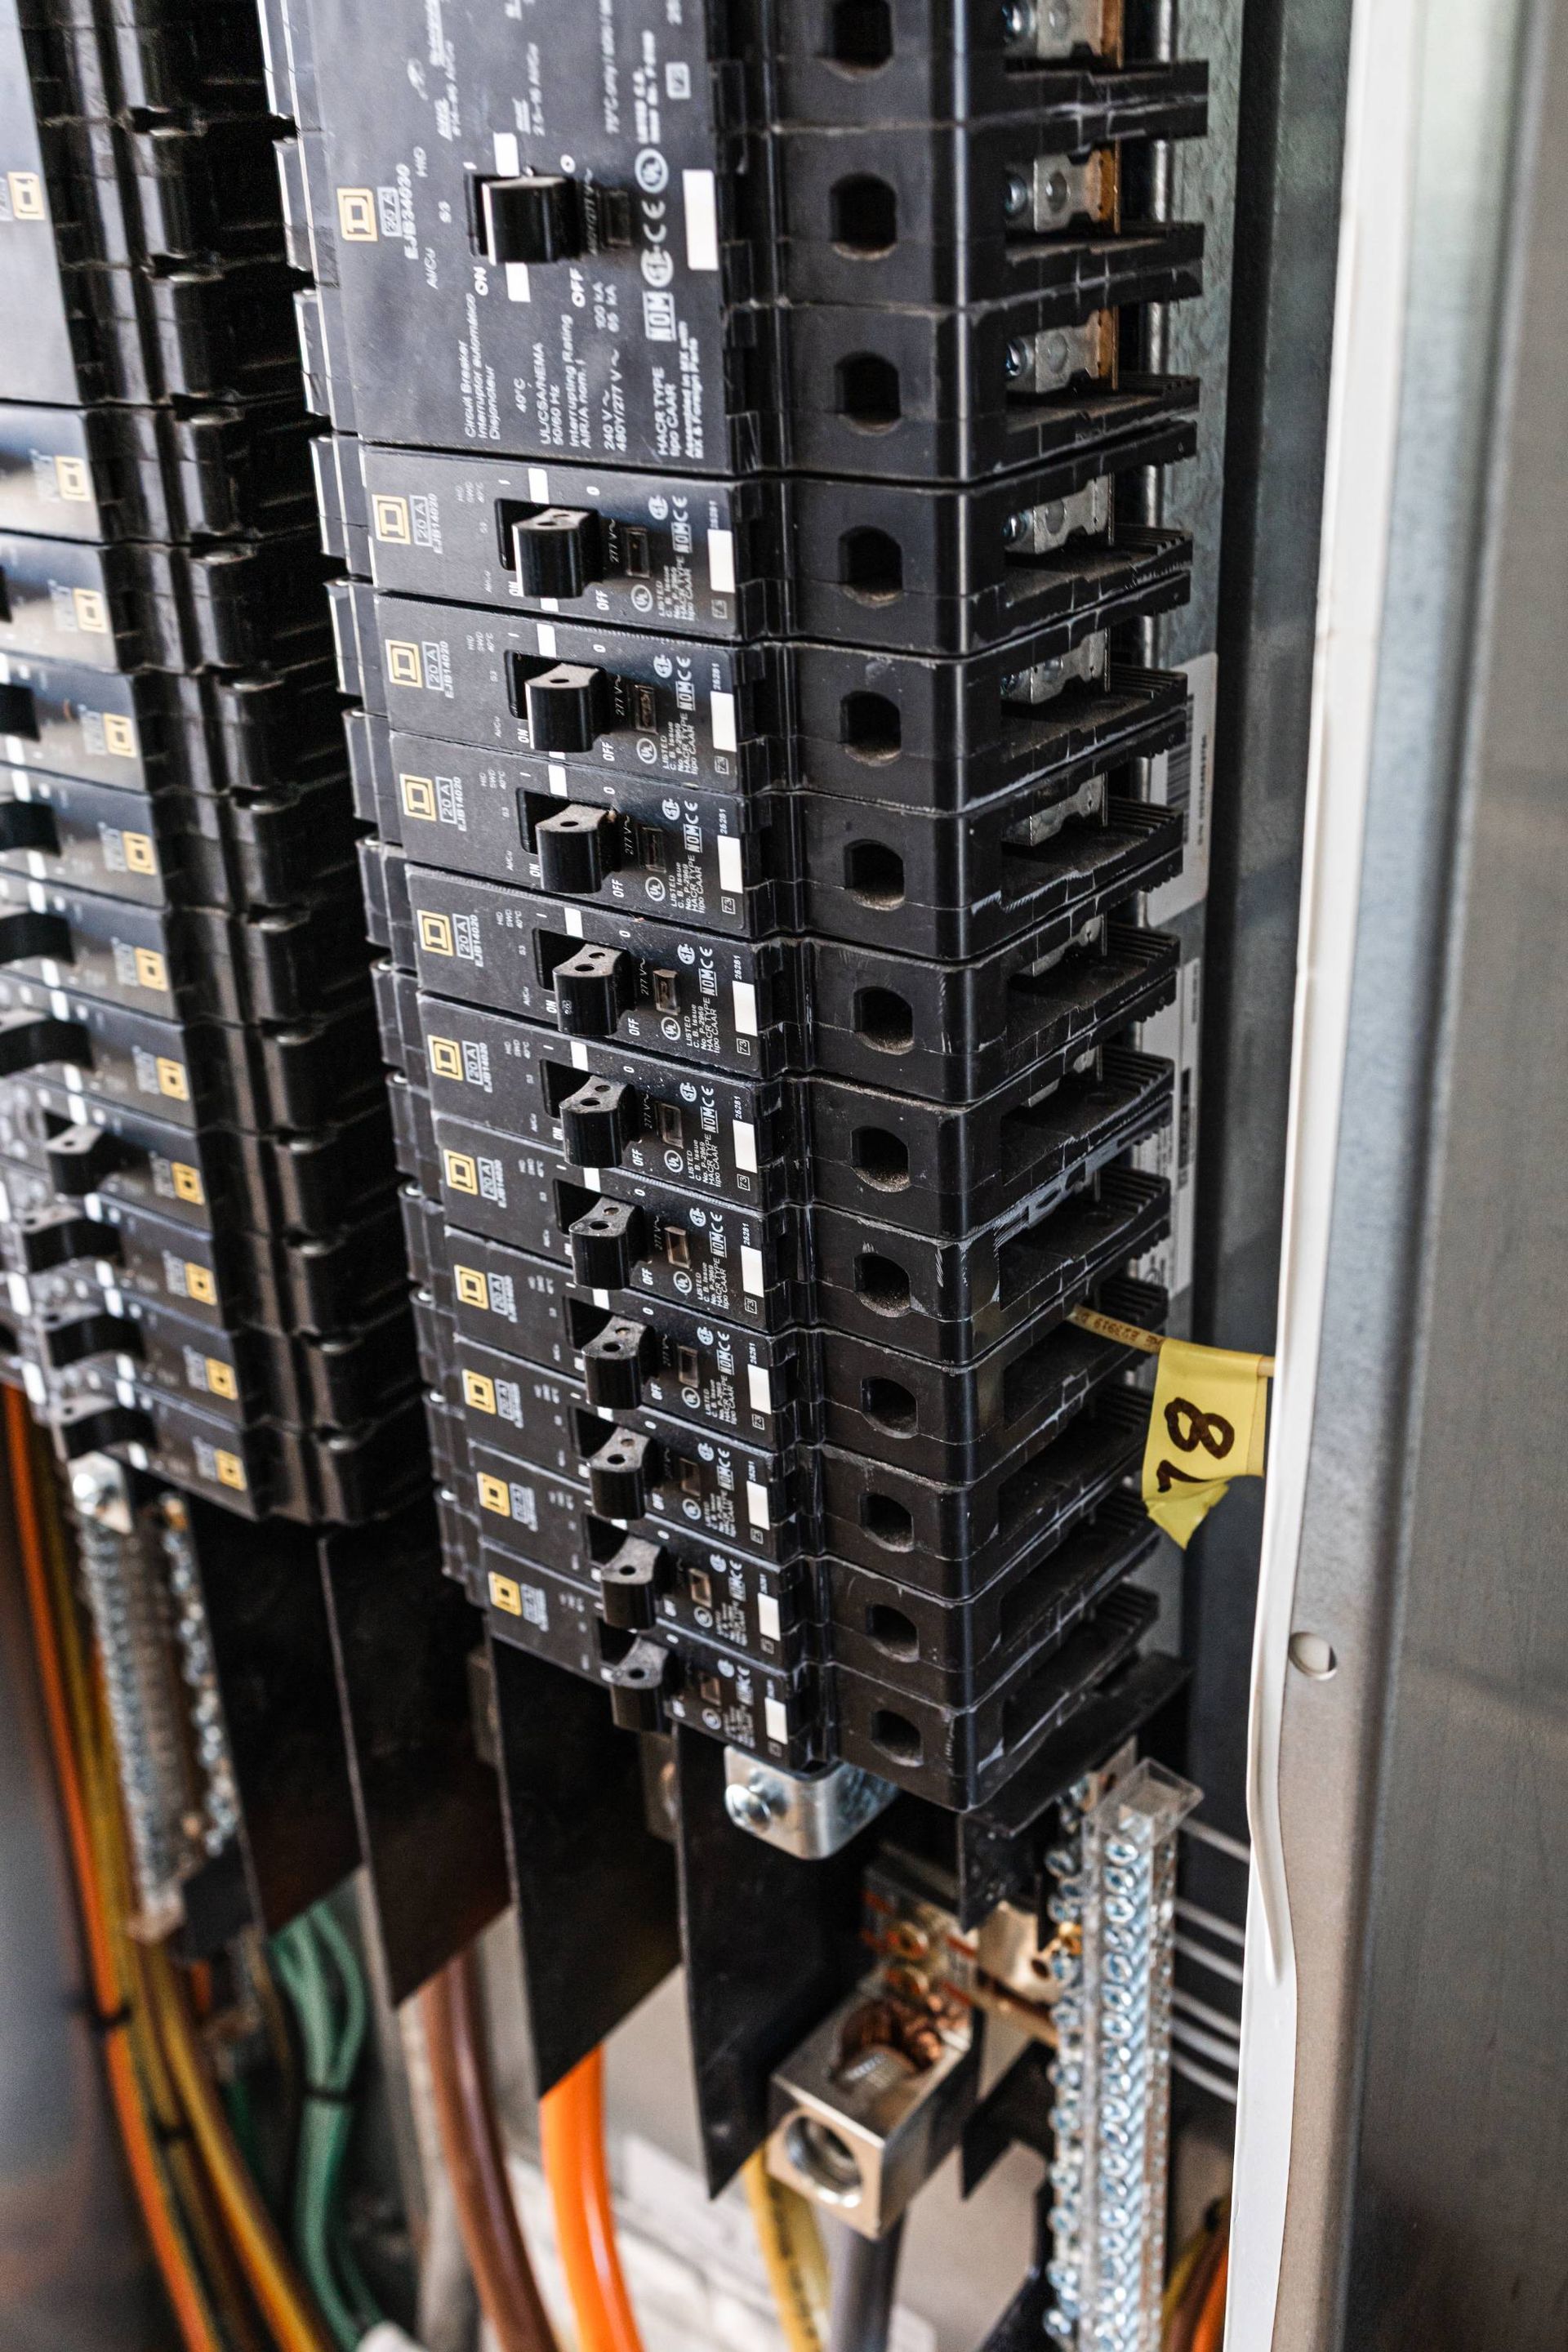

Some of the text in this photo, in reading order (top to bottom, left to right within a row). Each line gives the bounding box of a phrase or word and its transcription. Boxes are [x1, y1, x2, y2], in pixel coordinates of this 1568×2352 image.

[642, 200, 666, 243] CE
[474, 267, 488, 296] ON
[570, 268, 586, 307] OFF
[604, 284, 617, 305] kA
[592, 282, 606, 329] 100 kA
[646, 292, 673, 340] NOM
[458, 340, 472, 394] Breaker
[561, 314, 580, 447] Interrupting Rating
[610, 369, 622, 381] V
[473, 369, 488, 438] Interruptor
[485, 364, 501, 439] Disjoncteur
[514, 378, 526, 412] 40°C
[532, 342, 550, 444] UL/CSA/NEMA
[664, 383, 679, 428] CAAR
[550, 385, 564, 445] 50/60 Hz
[652, 367, 668, 456] HACR TYPE
[602, 409, 616, 450] 240 V
[413, 501, 425, 514] A
[672, 495, 688, 520] CE
[674, 521, 689, 552] NOM
[608, 542, 618, 561] 277
[595, 590, 608, 612] OFF
[425, 648, 439, 683] 20 A
[440, 640, 454, 698] EJB14020
[676, 656, 691, 681] CE
[614, 686, 624, 715] 277 V
[678, 681, 693, 710] NOM
[517, 728, 529, 743] ON
[666, 720, 675, 746] Issue
[679, 712, 688, 740] TYPE
[602, 742, 614, 762] OFF
[660, 735, 669, 768] LISTED
[439, 783, 452, 817] 20 A
[454, 776, 466, 832] EJB14020
[684, 800, 698, 824] CE
[623, 826, 633, 854] 277 V
[685, 824, 700, 853] NOM
[528, 862, 541, 878] ON
[682, 862, 690, 893] P-2969
[687, 853, 697, 911] HACR TYPE
[695, 866, 703, 893] CAAR
[612, 879, 624, 898] OFF
[668, 874, 677, 906] LISTED
[456, 920, 469, 952] 20 A
[470, 914, 483, 967] EJB14020
[699, 946, 714, 969] CE
[639, 968, 648, 995] 277 V
[701, 968, 715, 996] NOM
[545, 999, 557, 1013] ON
[697, 1004, 706, 1033] P-2969
[627, 1017, 639, 1036] OFF
[684, 1015, 693, 1046] LISTED
[702, 996, 713, 1051] HACR TYPE
[710, 1008, 718, 1035] CAAR
[466, 1046, 476, 1058] A
[701, 1085, 715, 1107] CE
[643, 1102, 652, 1129] 277 V
[702, 1106, 716, 1133] NOM
[552, 1126, 564, 1141] ON
[480, 1163, 491, 1175] A
[632, 1147, 644, 1166] OFF
[686, 1149, 694, 1178] LISTED
[704, 1133, 715, 1185] HACR TYPE
[711, 1144, 719, 1170] CAAR
[710, 1210, 724, 1233] CE
[653, 1233, 662, 1250] 277
[710, 1231, 724, 1257] NOM
[642, 1267, 653, 1285] OFF
[712, 1256, 720, 1280] TYPE
[491, 1278, 501, 1290] A
[694, 1272, 702, 1300] LISTED
[717, 1330, 730, 1352] CE
[718, 1349, 732, 1375] NOM
[651, 1382, 662, 1400] OFF
[702, 1388, 710, 1415] LISTED
[717, 1448, 730, 1468] CE
[1156, 1396, 1235, 1493] 18
